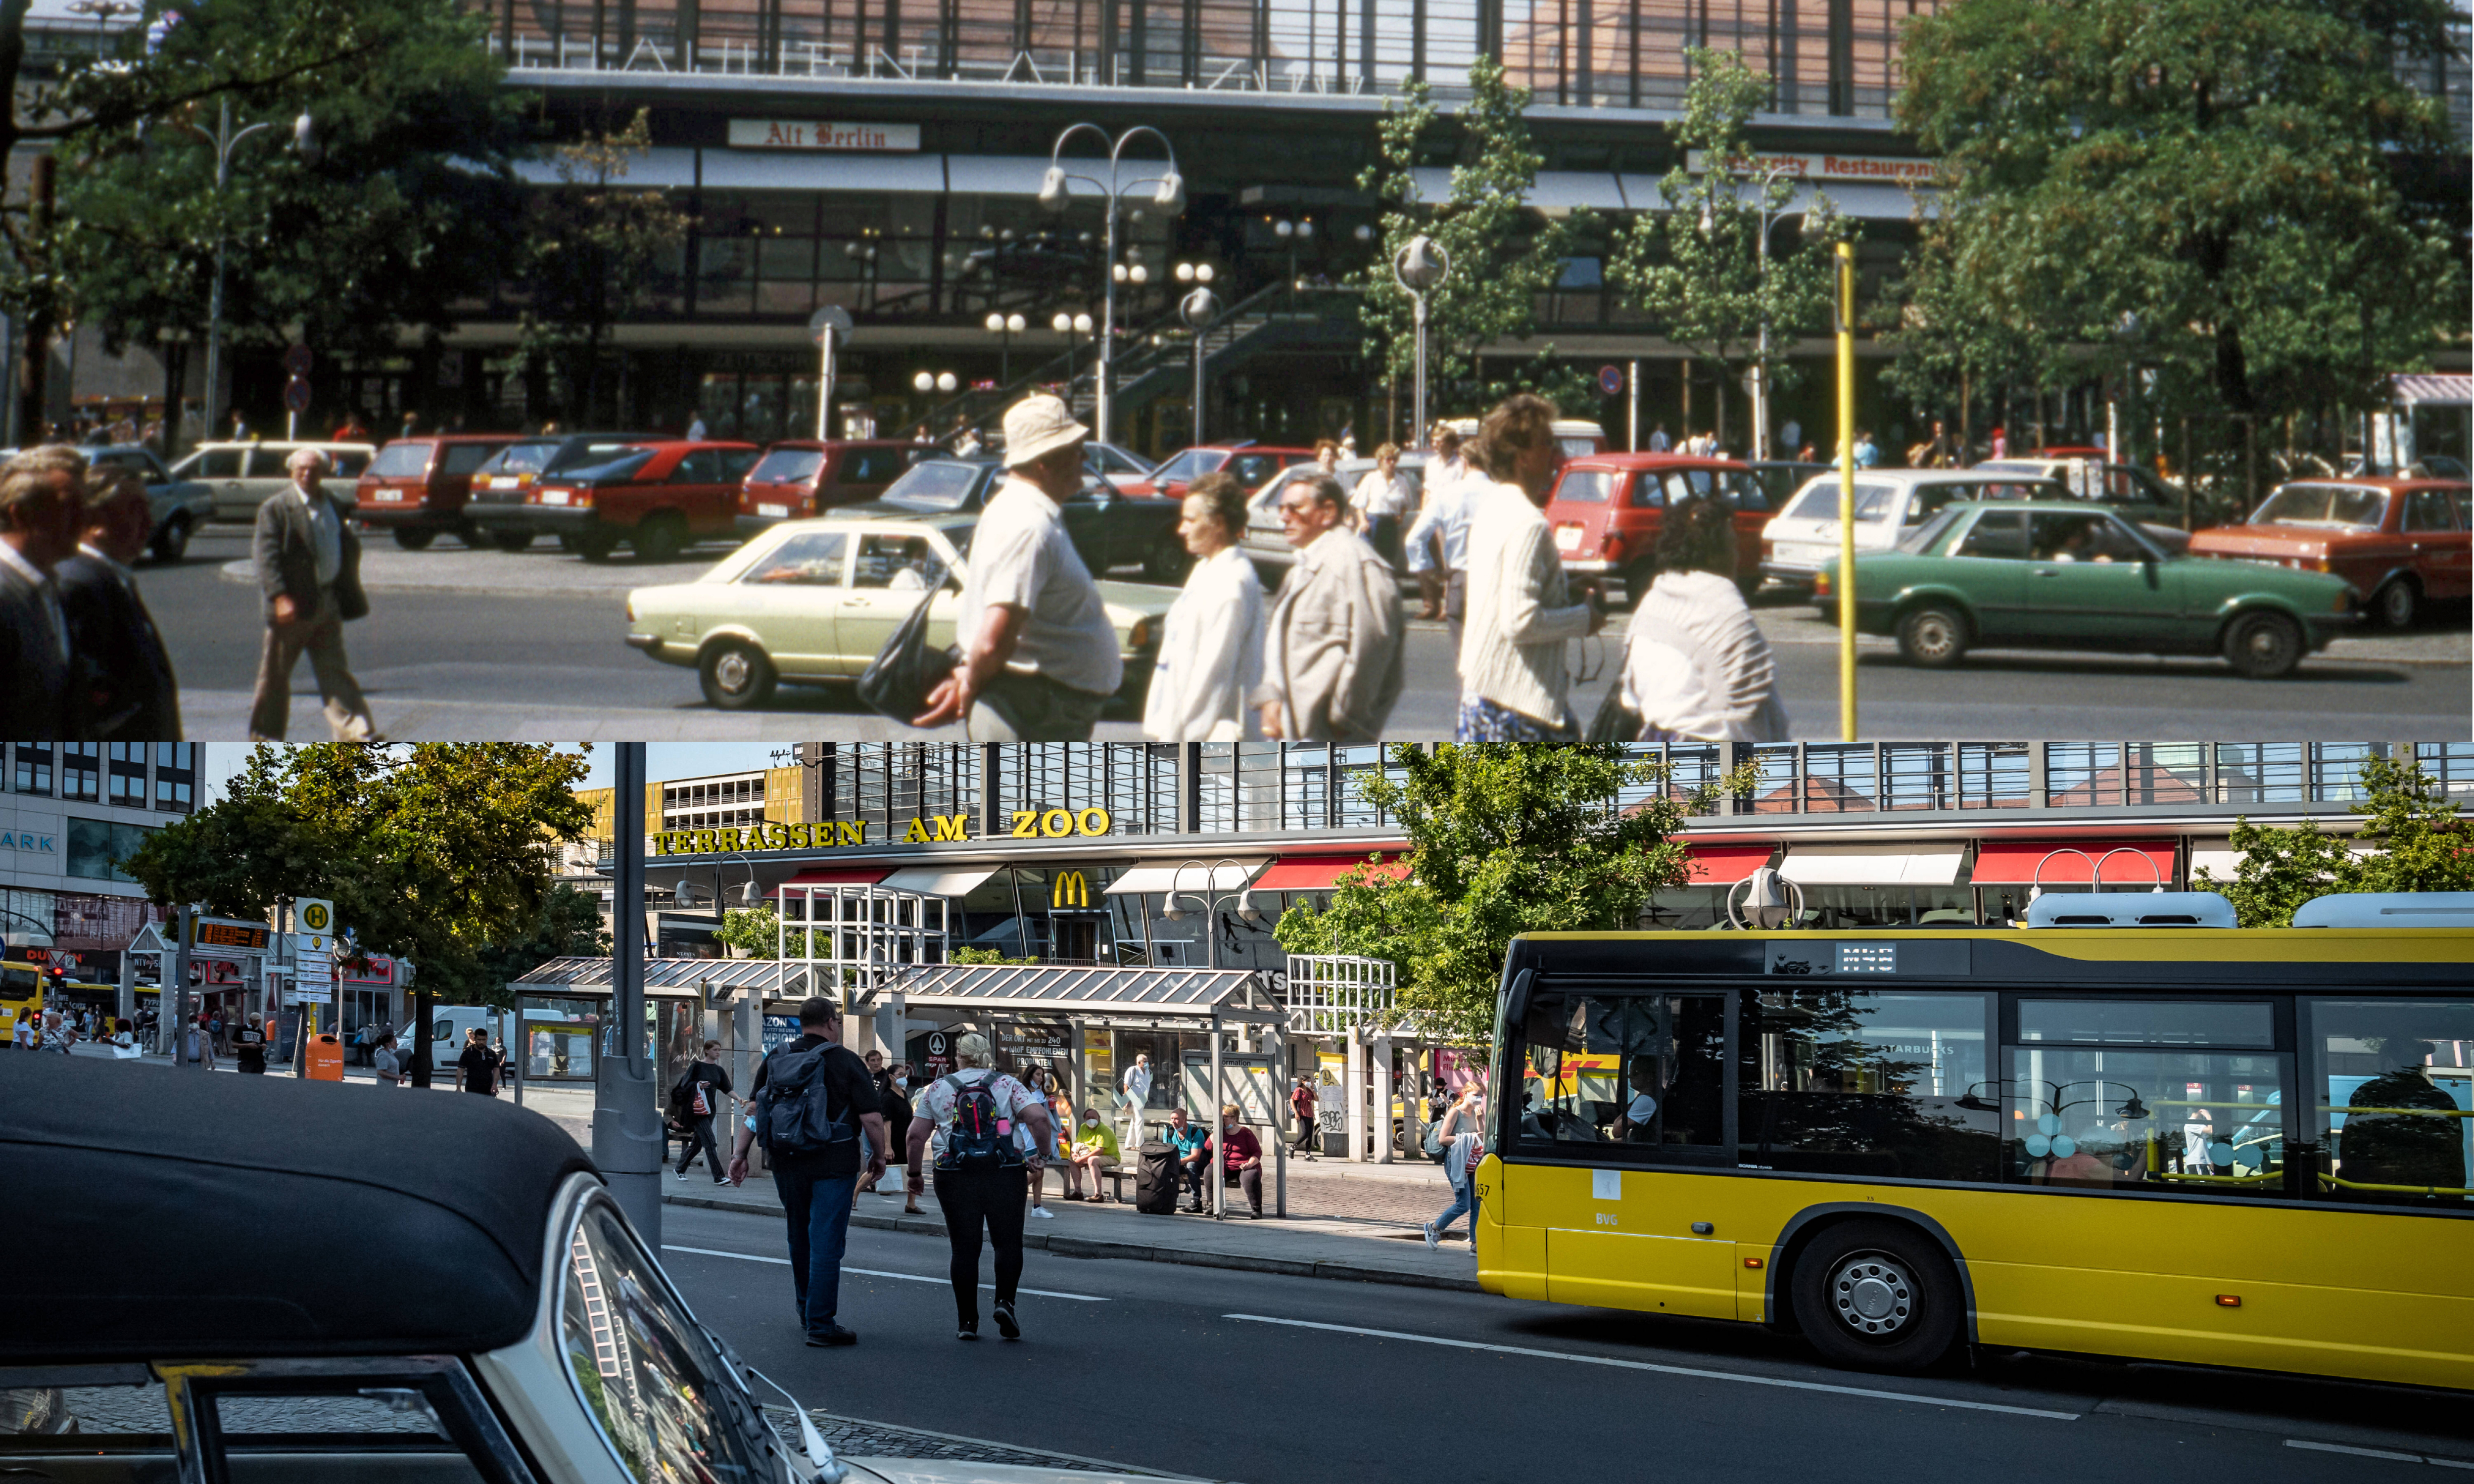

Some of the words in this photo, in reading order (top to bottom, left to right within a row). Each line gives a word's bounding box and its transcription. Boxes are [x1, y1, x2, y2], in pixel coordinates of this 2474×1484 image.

[764, 122, 802, 144] Alt
[814, 122, 886, 147] Berlin
[1824, 156, 1936, 177] Restauran
[653, 820, 869, 855] TERRASSEN
[903, 814, 969, 843] AM
[1012, 807, 1111, 838] ZOO
[311, 909, 323, 924] H
[762, 1017, 787, 1027] AZON
[763, 1033, 802, 1043] MPIONS
[1009, 1045, 1024, 1054] WWF
[1026, 1046, 1068, 1056] EMPFOHLENEN
[1880, 1044, 1954, 1055] STARBUKS
[1017, 1058, 1053, 1067] PRODUKTEN.
[1475, 1183, 1489, 1196] 657
[1596, 1212, 1618, 1225] BVG
